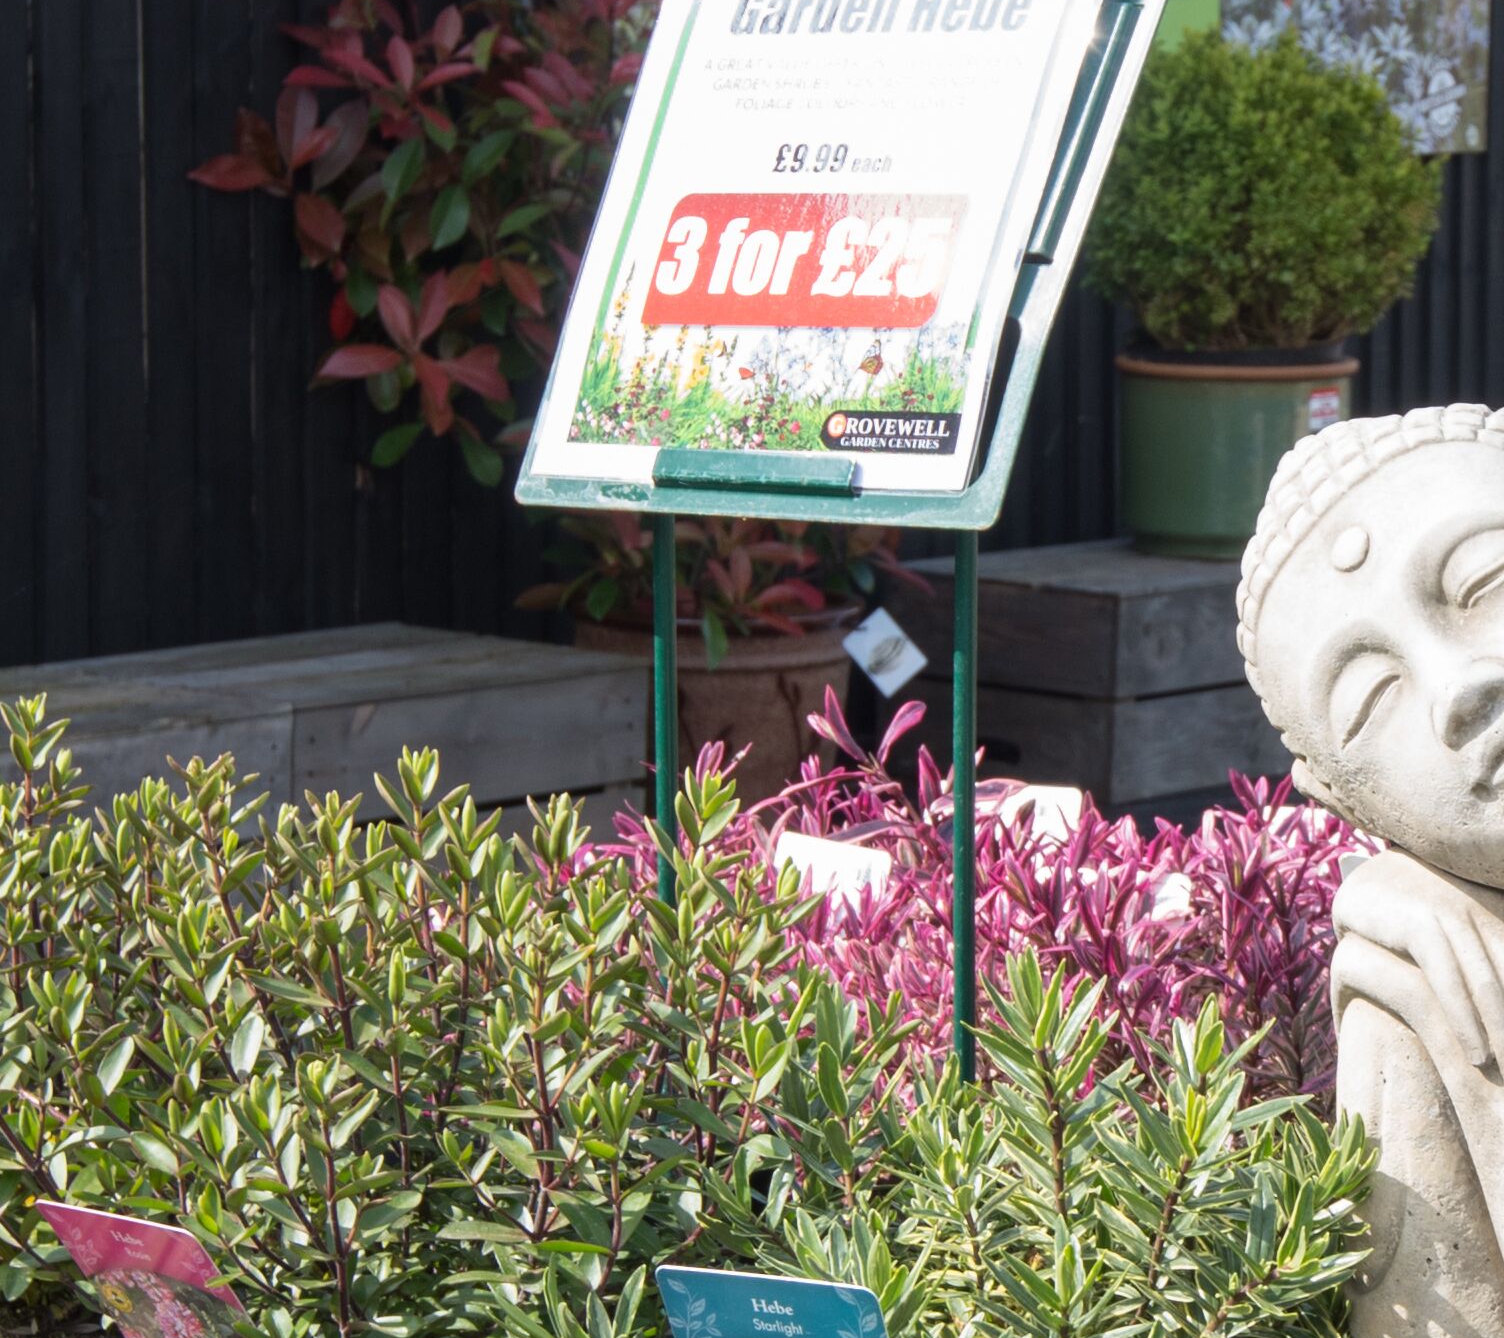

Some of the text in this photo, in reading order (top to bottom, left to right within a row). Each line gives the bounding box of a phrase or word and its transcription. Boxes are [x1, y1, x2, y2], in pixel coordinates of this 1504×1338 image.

[772, 143, 893, 173] £9.99 each
[655, 214, 958, 299] 3 for £25
[827, 413, 950, 438] GROVEWELL
[840, 436, 941, 450] GARDEN CENTRES
[110, 1230, 145, 1247] Hebe
[750, 1298, 794, 1316] Hebe
[752, 1318, 804, 1338] Starlight
